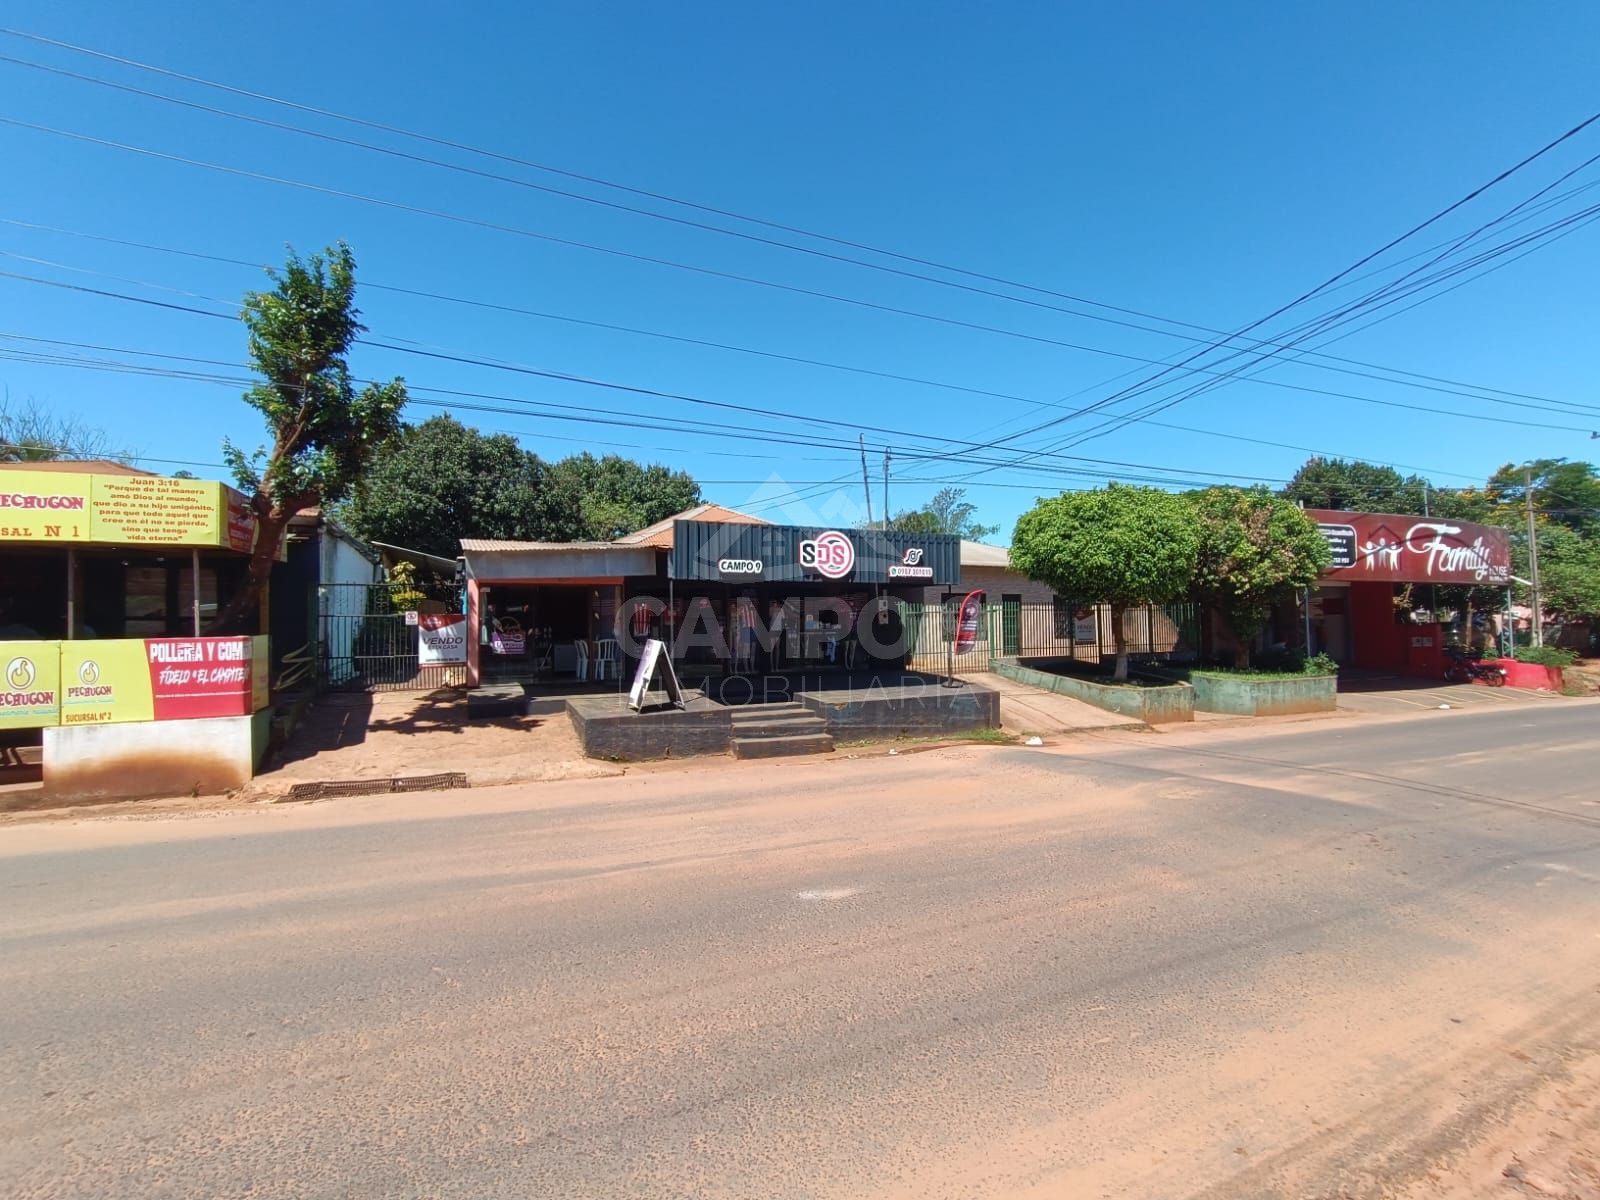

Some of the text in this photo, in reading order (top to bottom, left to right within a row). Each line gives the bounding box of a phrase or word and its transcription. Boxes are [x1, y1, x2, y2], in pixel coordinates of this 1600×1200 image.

[129, 478, 180, 487] Juan 3:16
[0, 494, 84, 509] ECHUGON
[1, 525, 80, 537] SAL N 1
[162, 527, 188, 535] tenga
[801, 541, 846, 567] SDS
[1406, 523, 1490, 580] Family
[720, 560, 762, 573] CAMPO 9
[424, 636, 464, 646] VENDO
[207, 641, 216, 661] Y
[67, 685, 112, 697] PECHUGON
[0, 691, 54, 706] ECHUGON
[66, 713, 99, 723] SUCURSAL
